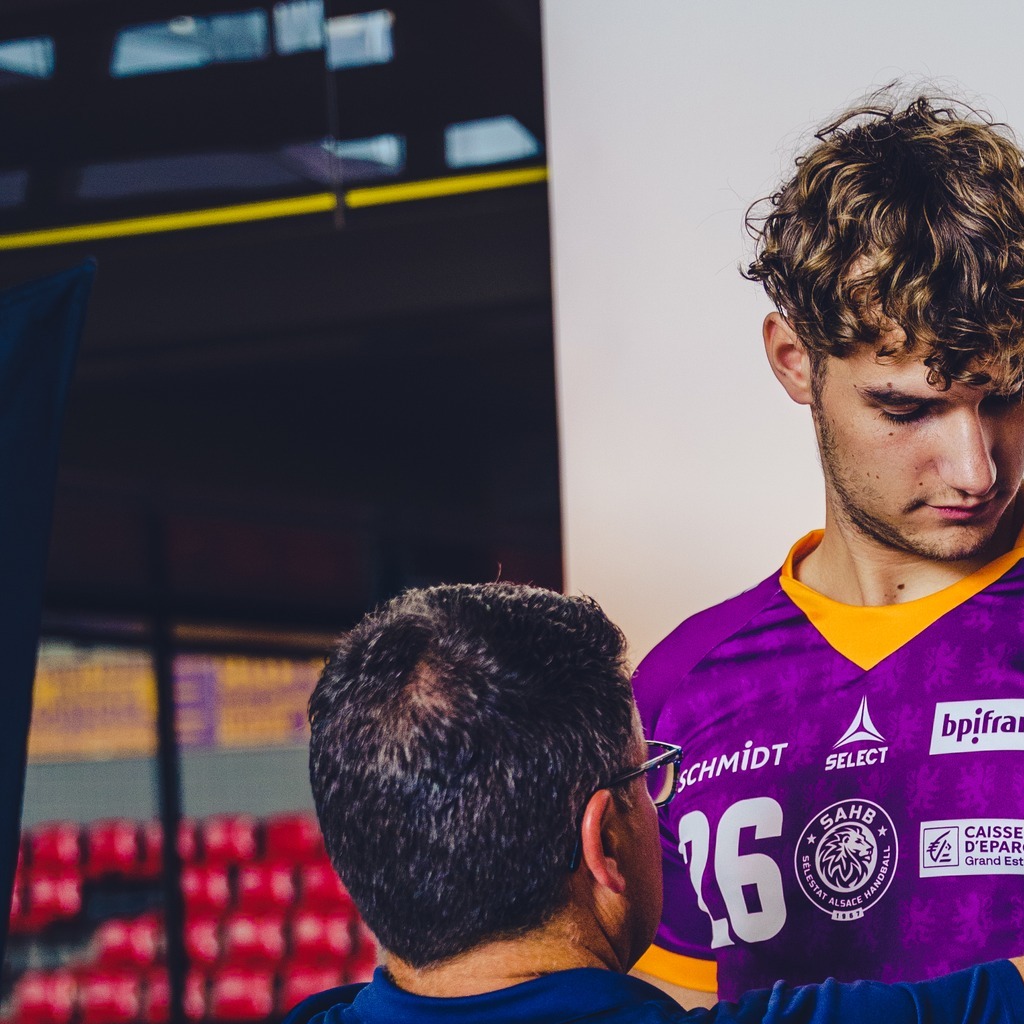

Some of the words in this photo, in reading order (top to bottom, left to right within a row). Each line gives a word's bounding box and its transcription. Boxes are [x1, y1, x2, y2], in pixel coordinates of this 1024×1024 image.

[825, 746, 889, 772] SELECT
[819, 804, 877, 831] SAHB
[964, 825, 1024, 840] CAISSE
[677, 796, 788, 950] 26
[964, 855, 1001, 867] Grand
[1004, 856, 1024, 867] Est
[828, 895, 864, 908] ALSACE
[863, 845, 891, 900] HANDBALL
[836, 910, 860, 920] 1967
